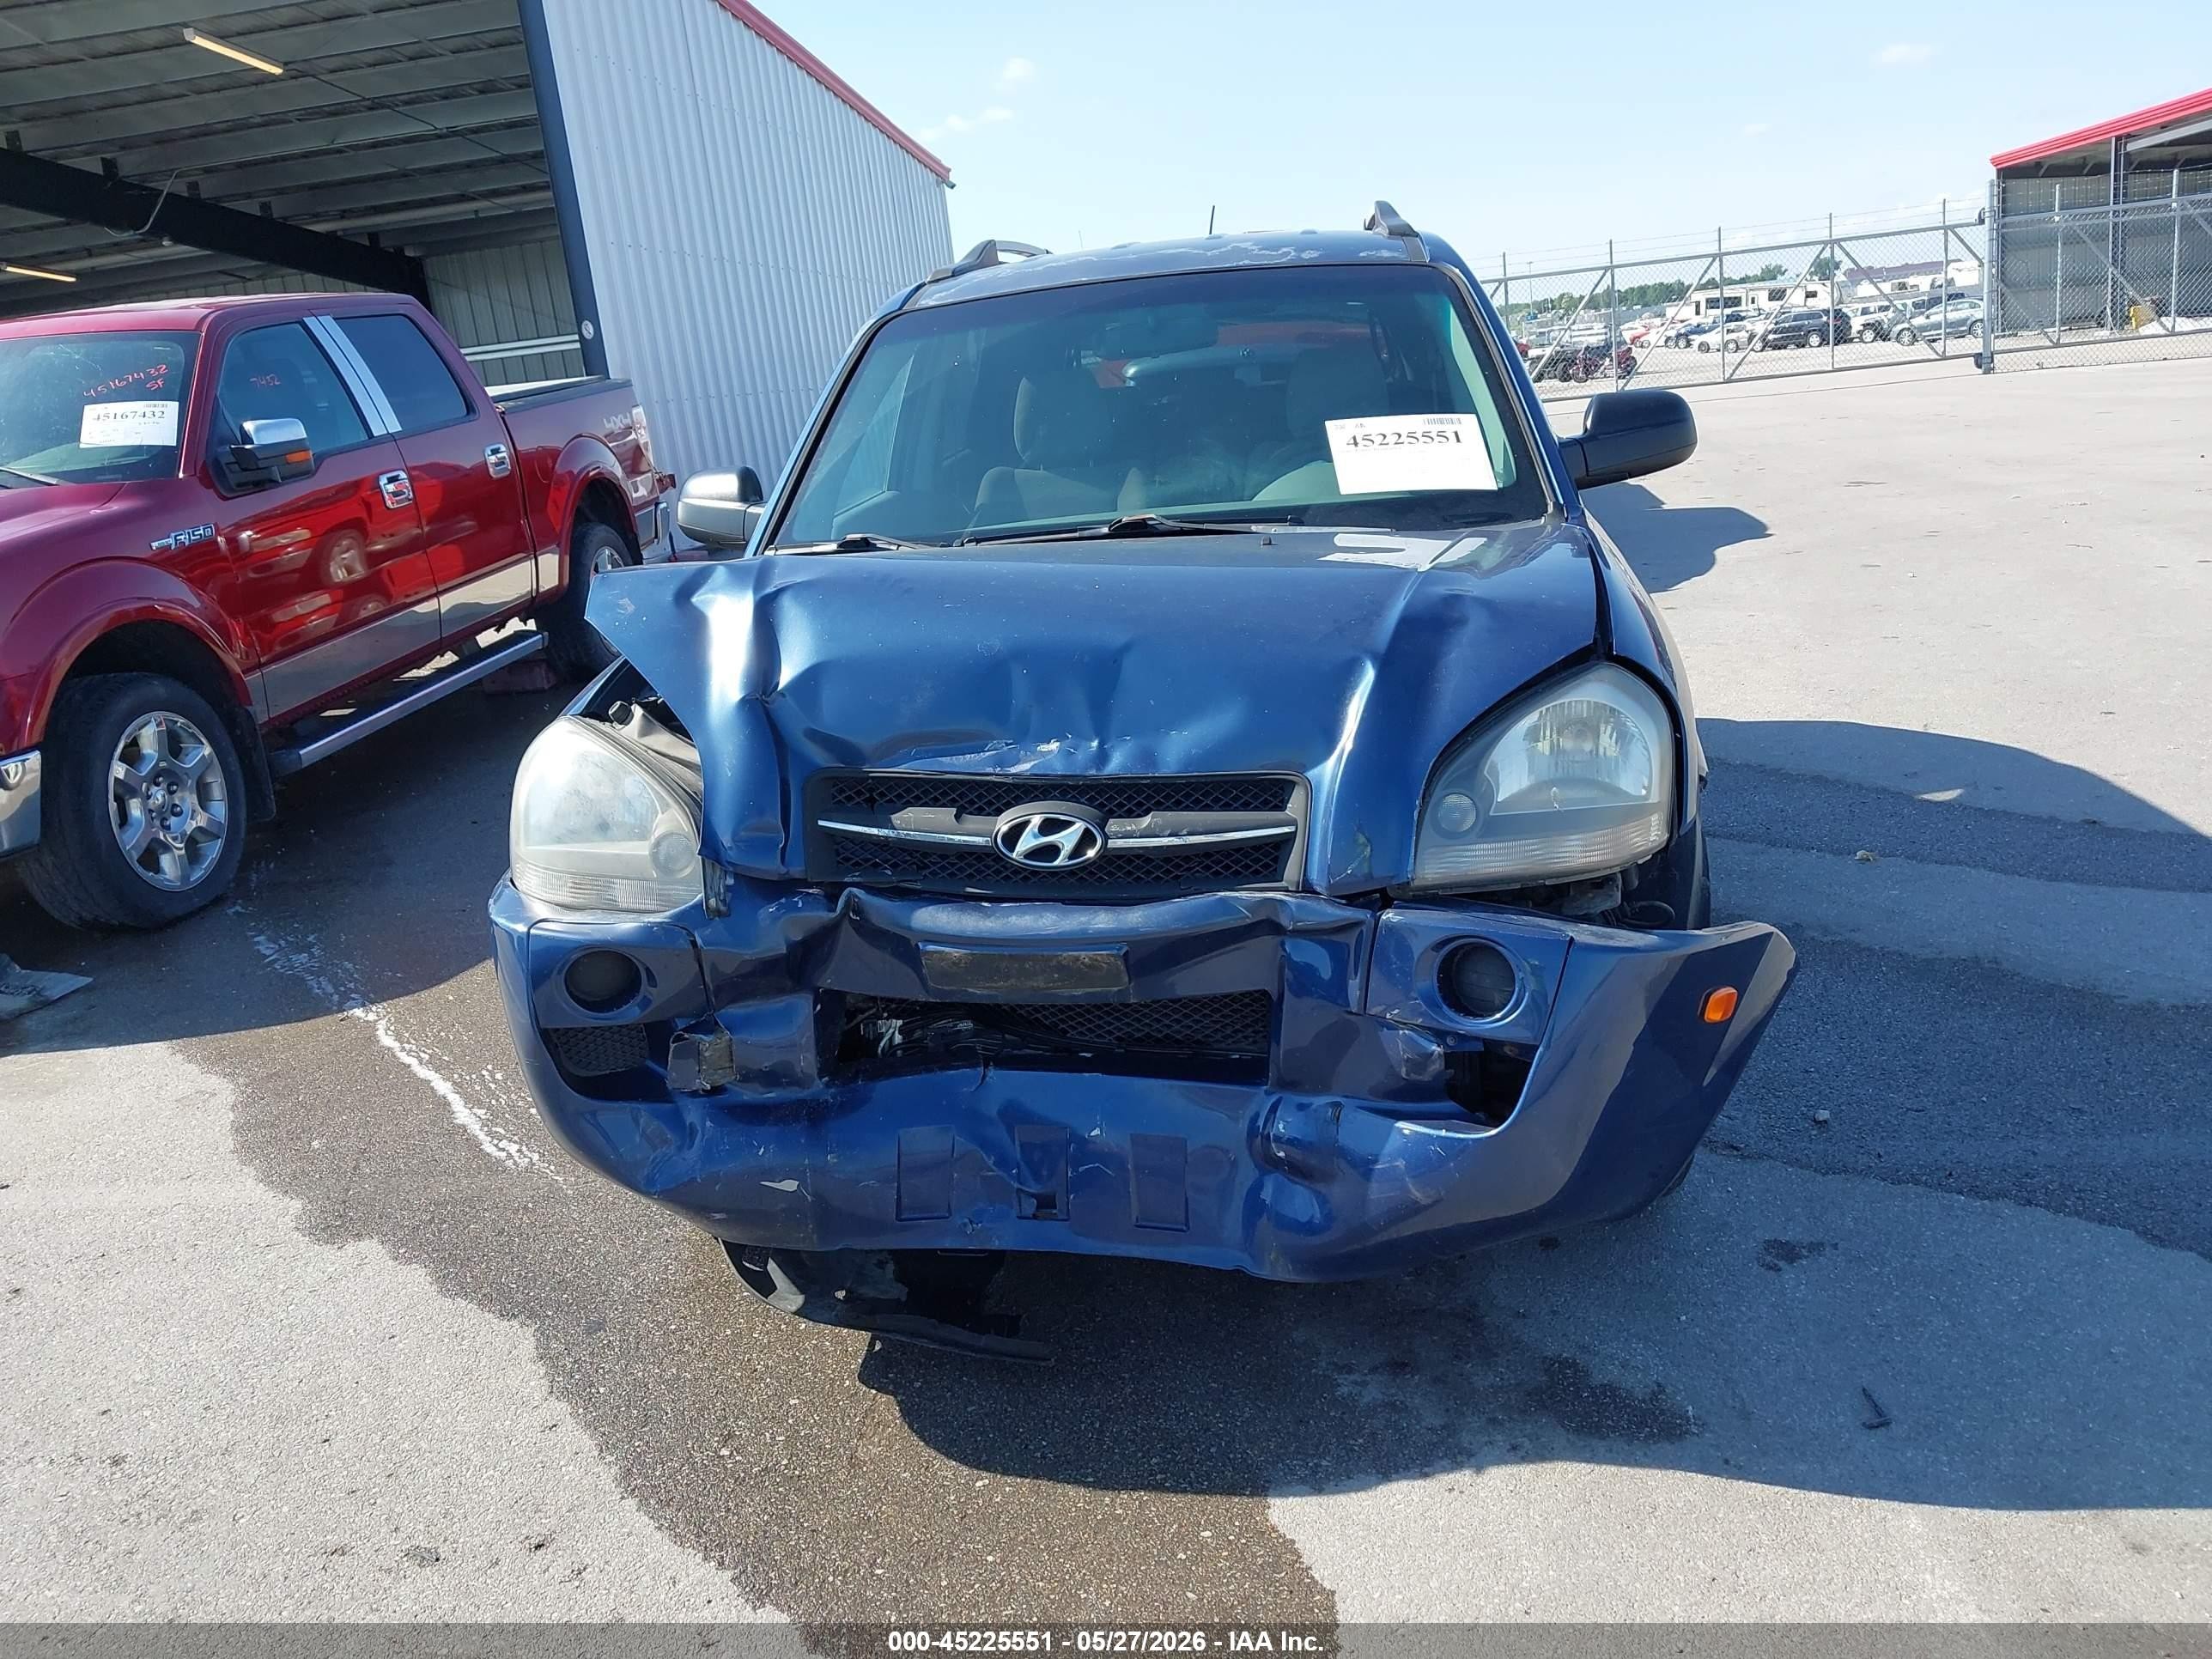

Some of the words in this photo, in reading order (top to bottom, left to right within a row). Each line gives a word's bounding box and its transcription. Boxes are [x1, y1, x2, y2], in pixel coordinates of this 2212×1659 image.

[83, 364, 168, 398] 45167432
[93, 410, 166, 422] 45167432
[1346, 430, 1463, 447] 45225551
